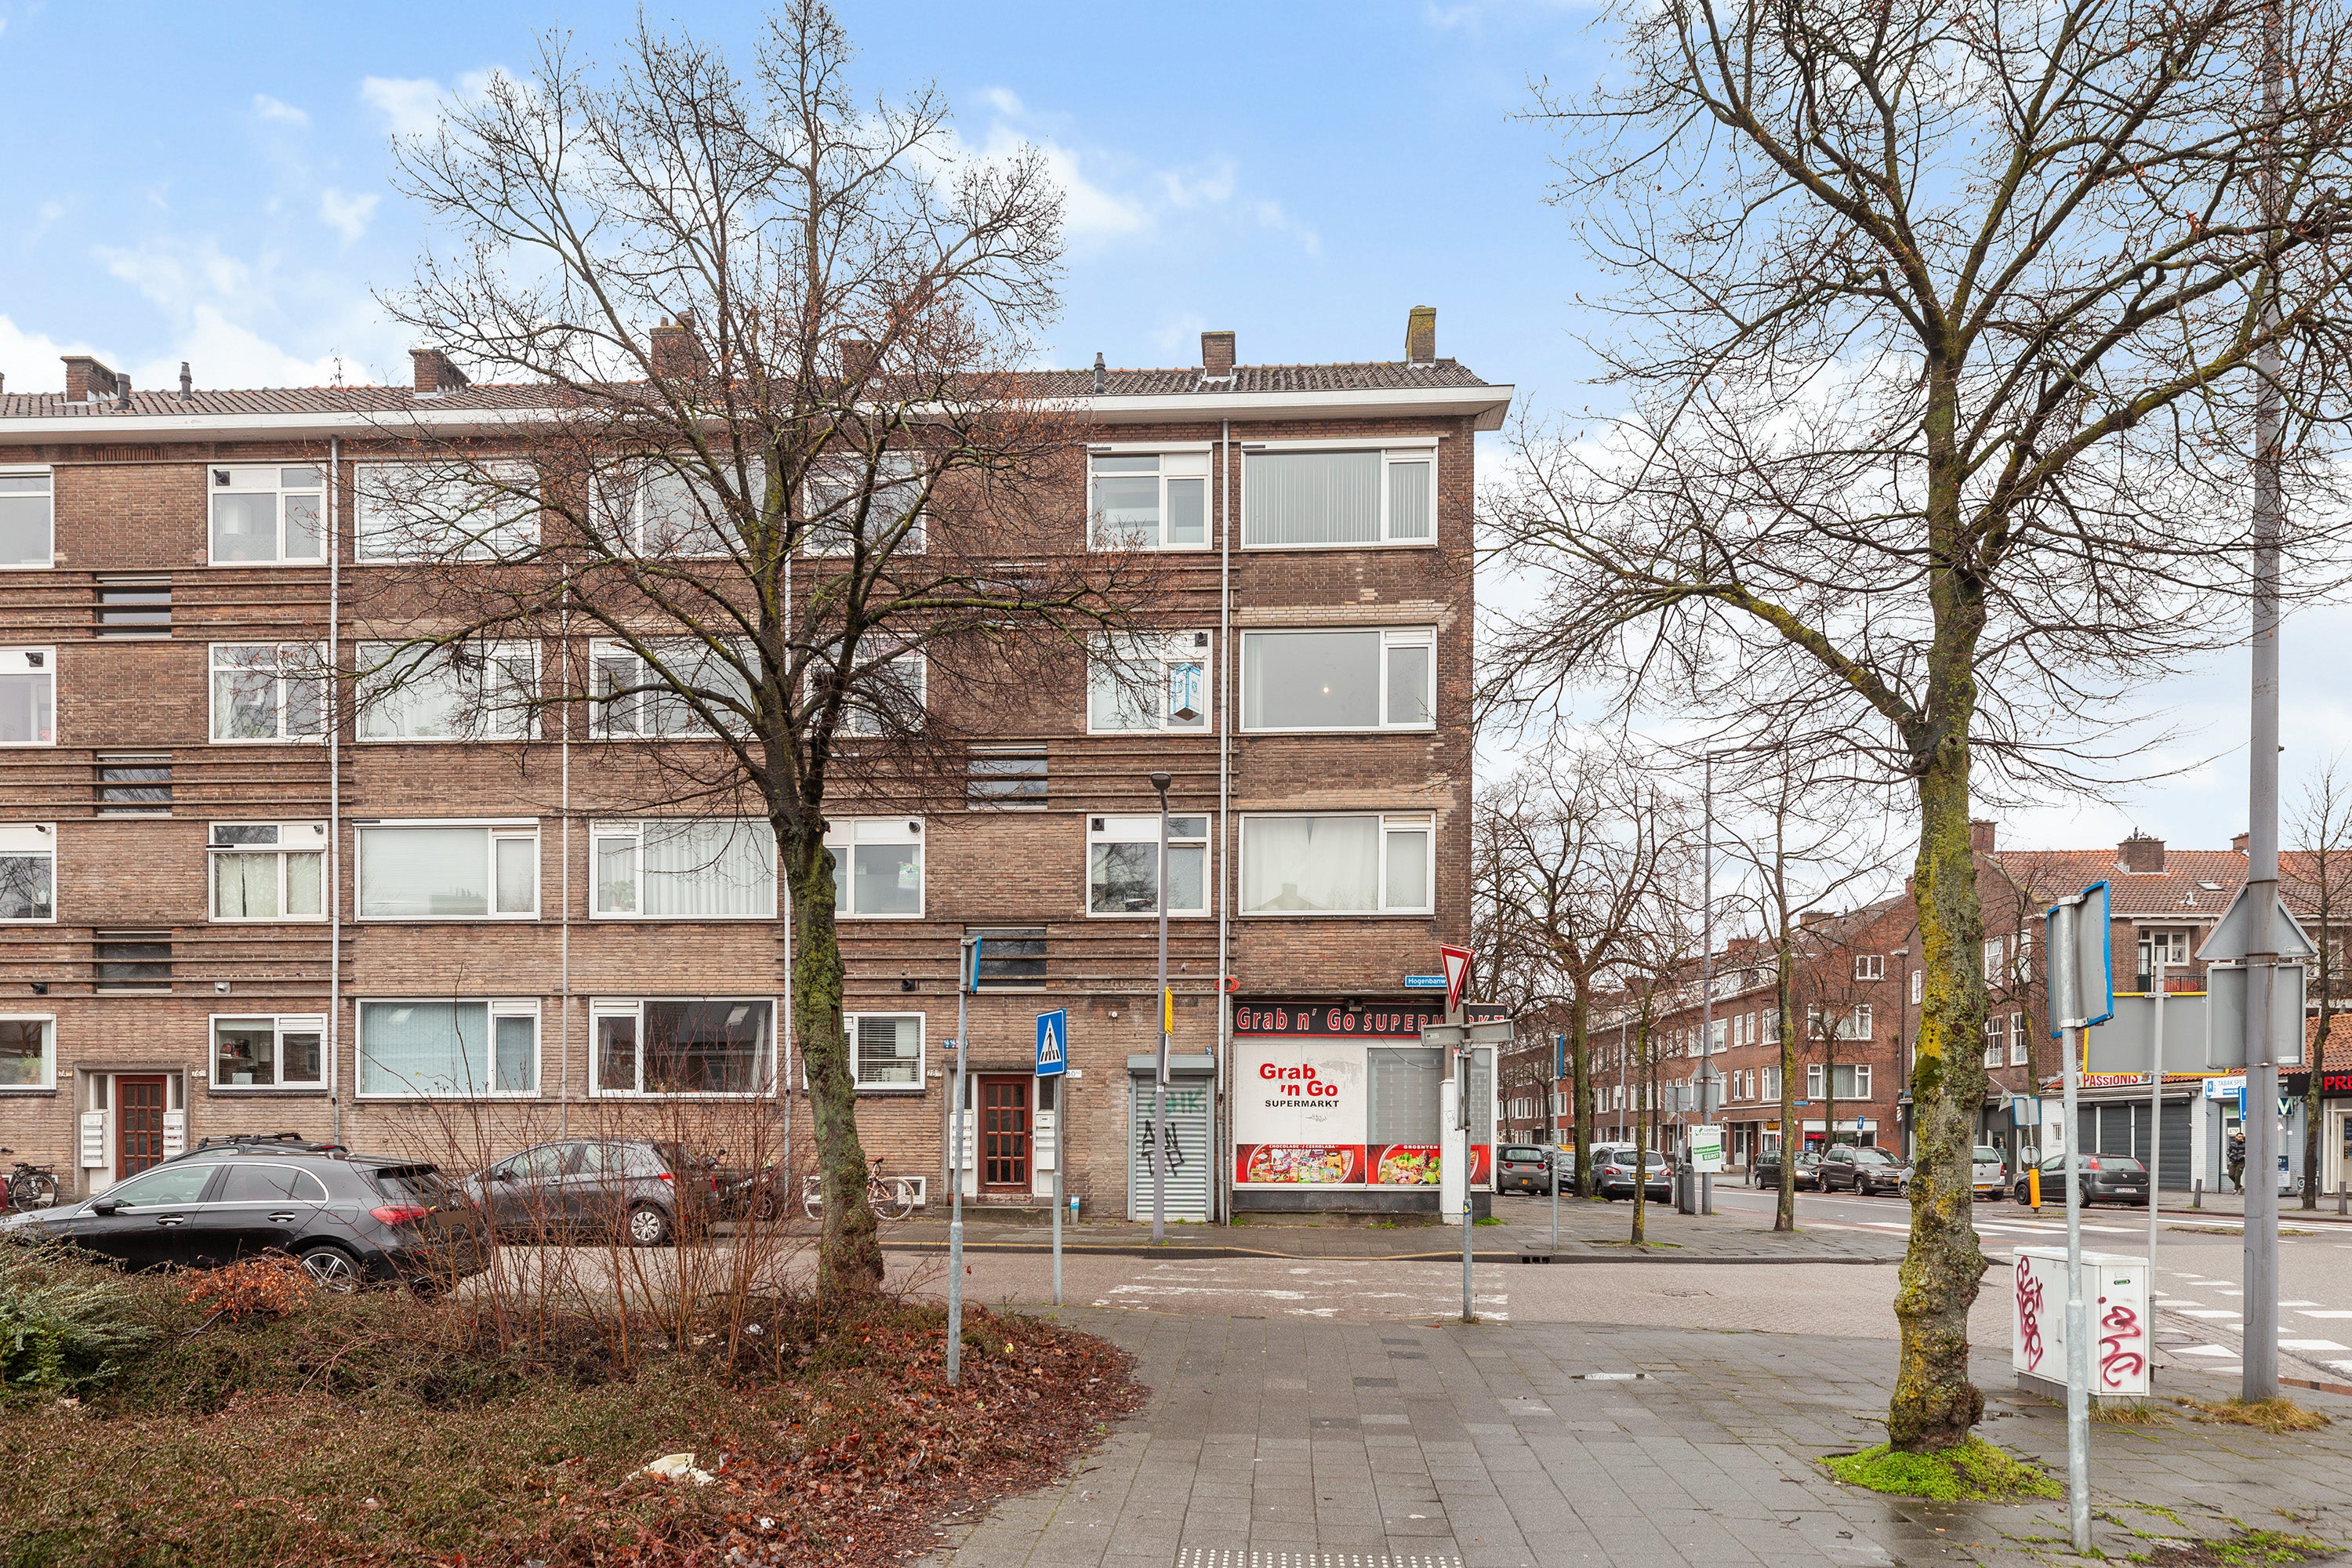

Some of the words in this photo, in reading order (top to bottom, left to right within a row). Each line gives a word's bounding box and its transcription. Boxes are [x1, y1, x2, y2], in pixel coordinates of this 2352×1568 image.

[1236, 1007, 1287, 1030] Grab
[1327, 1008, 1355, 1031] Go
[1363, 1014, 1505, 1032] SUPERM
[1259, 1062, 1316, 1080] Grab
[1306, 1080, 1338, 1097] Go
